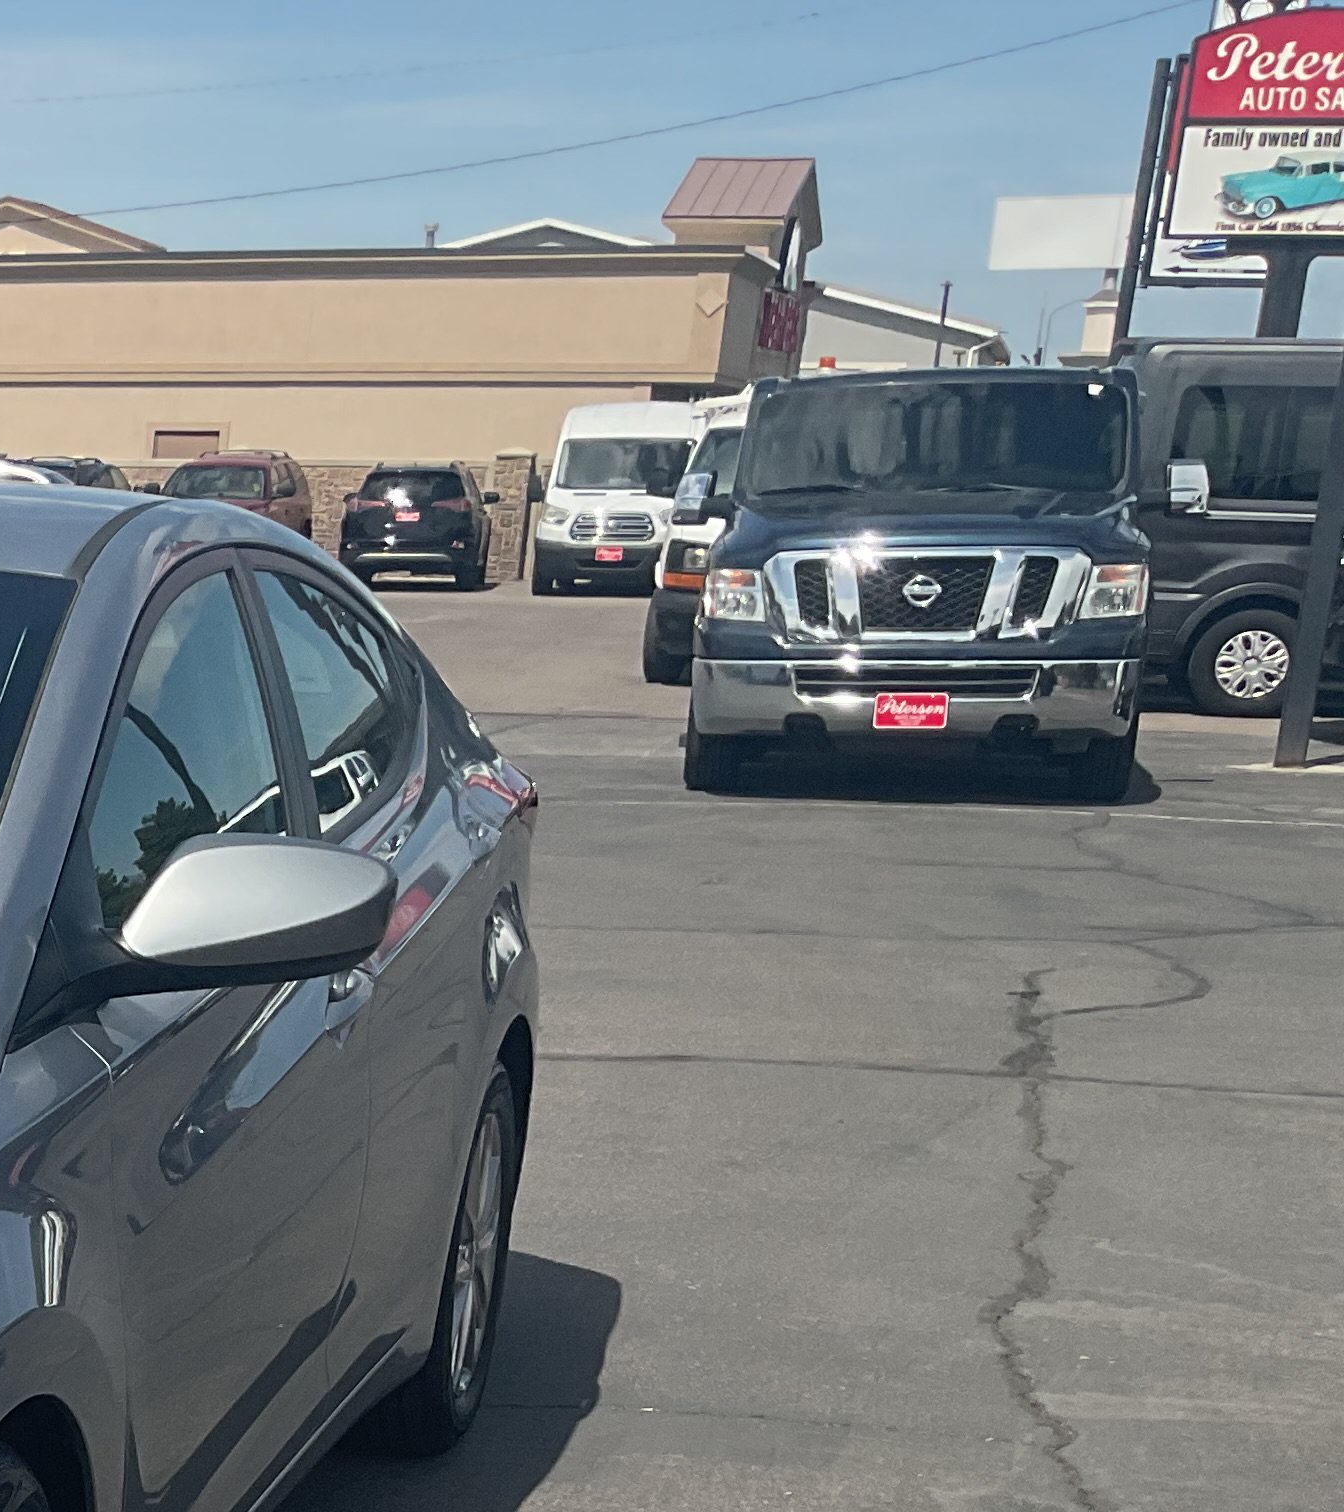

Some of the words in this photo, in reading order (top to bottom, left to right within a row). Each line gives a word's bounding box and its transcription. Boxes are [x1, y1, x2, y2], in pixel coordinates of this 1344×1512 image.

[1239, 87, 1308, 111] AUTO
[1204, 128, 1254, 150] Family
[1258, 129, 1310, 148] owned
[1313, 129, 1343, 148] and
[878, 698, 945, 715] Peterson
